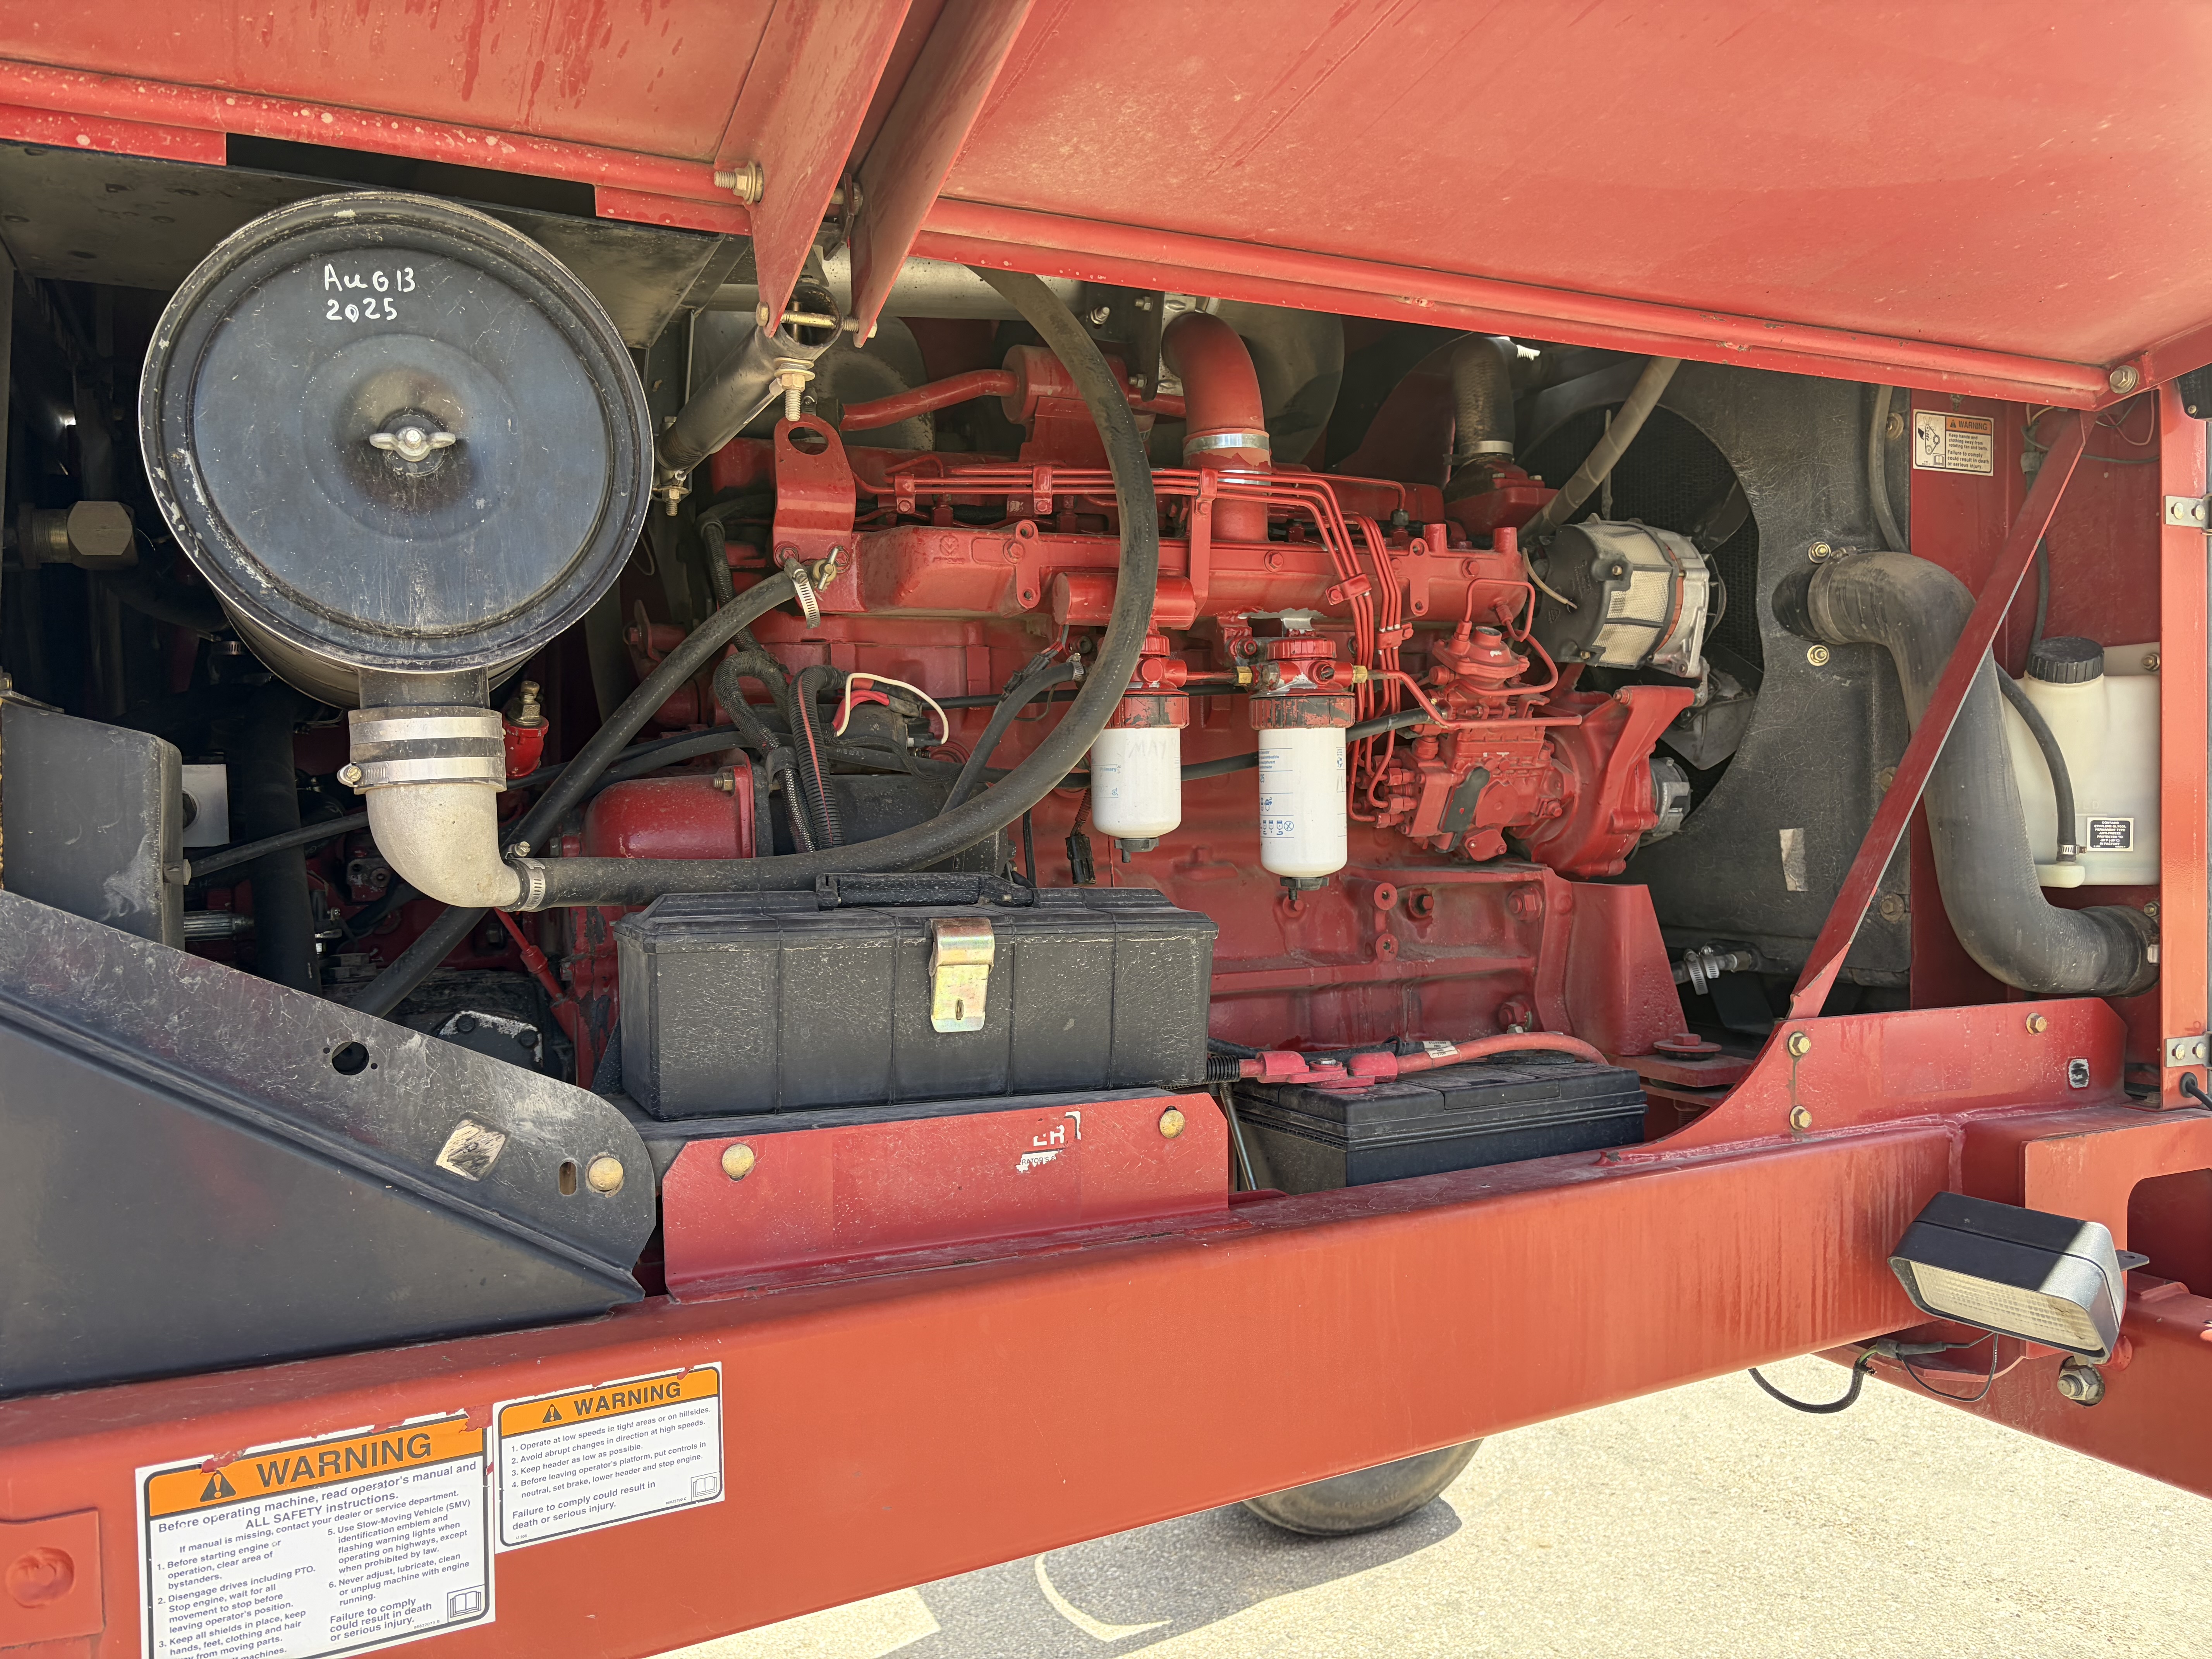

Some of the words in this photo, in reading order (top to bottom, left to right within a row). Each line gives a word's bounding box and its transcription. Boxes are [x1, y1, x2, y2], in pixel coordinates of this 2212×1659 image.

[326, 298, 397, 323] 2025
[1959, 421, 1987, 430] WARNING
[574, 1381, 681, 1416] WARNING
[520, 1439, 551, 1451] Operate
[579, 1428, 606, 1439] speeds
[617, 1422, 634, 1431] tight
[636, 1418, 656, 1426] areas
[679, 1408, 710, 1418] hillsides.
[520, 1451, 542, 1462] Avoid
[544, 1446, 570, 1457] abrupt
[572, 1440, 604, 1451] changes
[616, 1431, 648, 1442] direction
[660, 1425, 675, 1433] high
[678, 1420, 705, 1430] speeds.
[256, 1433, 431, 1487] WARNING
[521, 1466, 541, 1474] Keep
[543, 1459, 569, 1469] header
[609, 1444, 643, 1457] possible.
[521, 1476, 546, 1486] Before
[549, 1470, 576, 1480] leaving
[579, 1460, 617, 1474] operator's
[620, 1454, 652, 1466] platform,
[654, 1449, 666, 1459] put
[668, 1444, 697, 1455] controls
[521, 1486, 551, 1498] neutral,
[567, 1479, 590, 1488] brake,
[592, 1474, 613, 1482] lower
[615, 1467, 641, 1477] header
[643, 1463, 656, 1472] and
[677, 1455, 702, 1464] engine.
[159, 1519, 198, 1532] Before
[203, 1506, 260, 1525] operating
[265, 1496, 318, 1511] machine,
[322, 1487, 347, 1500] read
[351, 1476, 409, 1495] operator's
[413, 1466, 452, 1482] manual
[456, 1461, 476, 1473] and
[246, 1517, 270, 1529] ALL
[273, 1505, 322, 1523] SAFETY
[326, 1493, 398, 1513] instructions.
[513, 1507, 544, 1519] Failure
[558, 1496, 590, 1508] comply
[593, 1488, 617, 1501] could
[620, 1483, 645, 1494] result
[188, 1538, 222, 1551] manual
[235, 1530, 273, 1541] missing,
[276, 1521, 309, 1533] contact
[312, 1517, 331, 1528] your
[334, 1511, 361, 1521] dealer
[376, 1502, 406, 1513] service
[409, 1490, 459, 1506] department.
[338, 1527, 394, 1543] identification
[397, 1519, 430, 1531] emblem
[433, 1513, 448, 1523] and
[357, 1513, 411, 1529] Slow-Moving
[414, 1506, 443, 1517] Vehicle
[446, 1499, 470, 1511] (SMV)
[513, 1518, 538, 1530] death
[553, 1508, 586, 1521] serious
[589, 1501, 616, 1513] injury.
[338, 1542, 373, 1553] flashing
[376, 1534, 410, 1545] warning
[413, 1528, 435, 1538] lights
[438, 1522, 460, 1531] when
[338, 1550, 380, 1564] operating
[396, 1538, 438, 1551] highways,
[440, 1530, 467, 1541] except
[338, 1564, 362, 1573] when
[365, 1553, 407, 1570] prohibited
[330, 1611, 364, 1624] Failure
[380, 1598, 416, 1612] comply
[330, 1620, 358, 1632] could
[362, 1613, 390, 1625] result
[404, 1603, 431, 1615] death
[344, 1625, 381, 1638] serious
[384, 1617, 414, 1629] injury.
